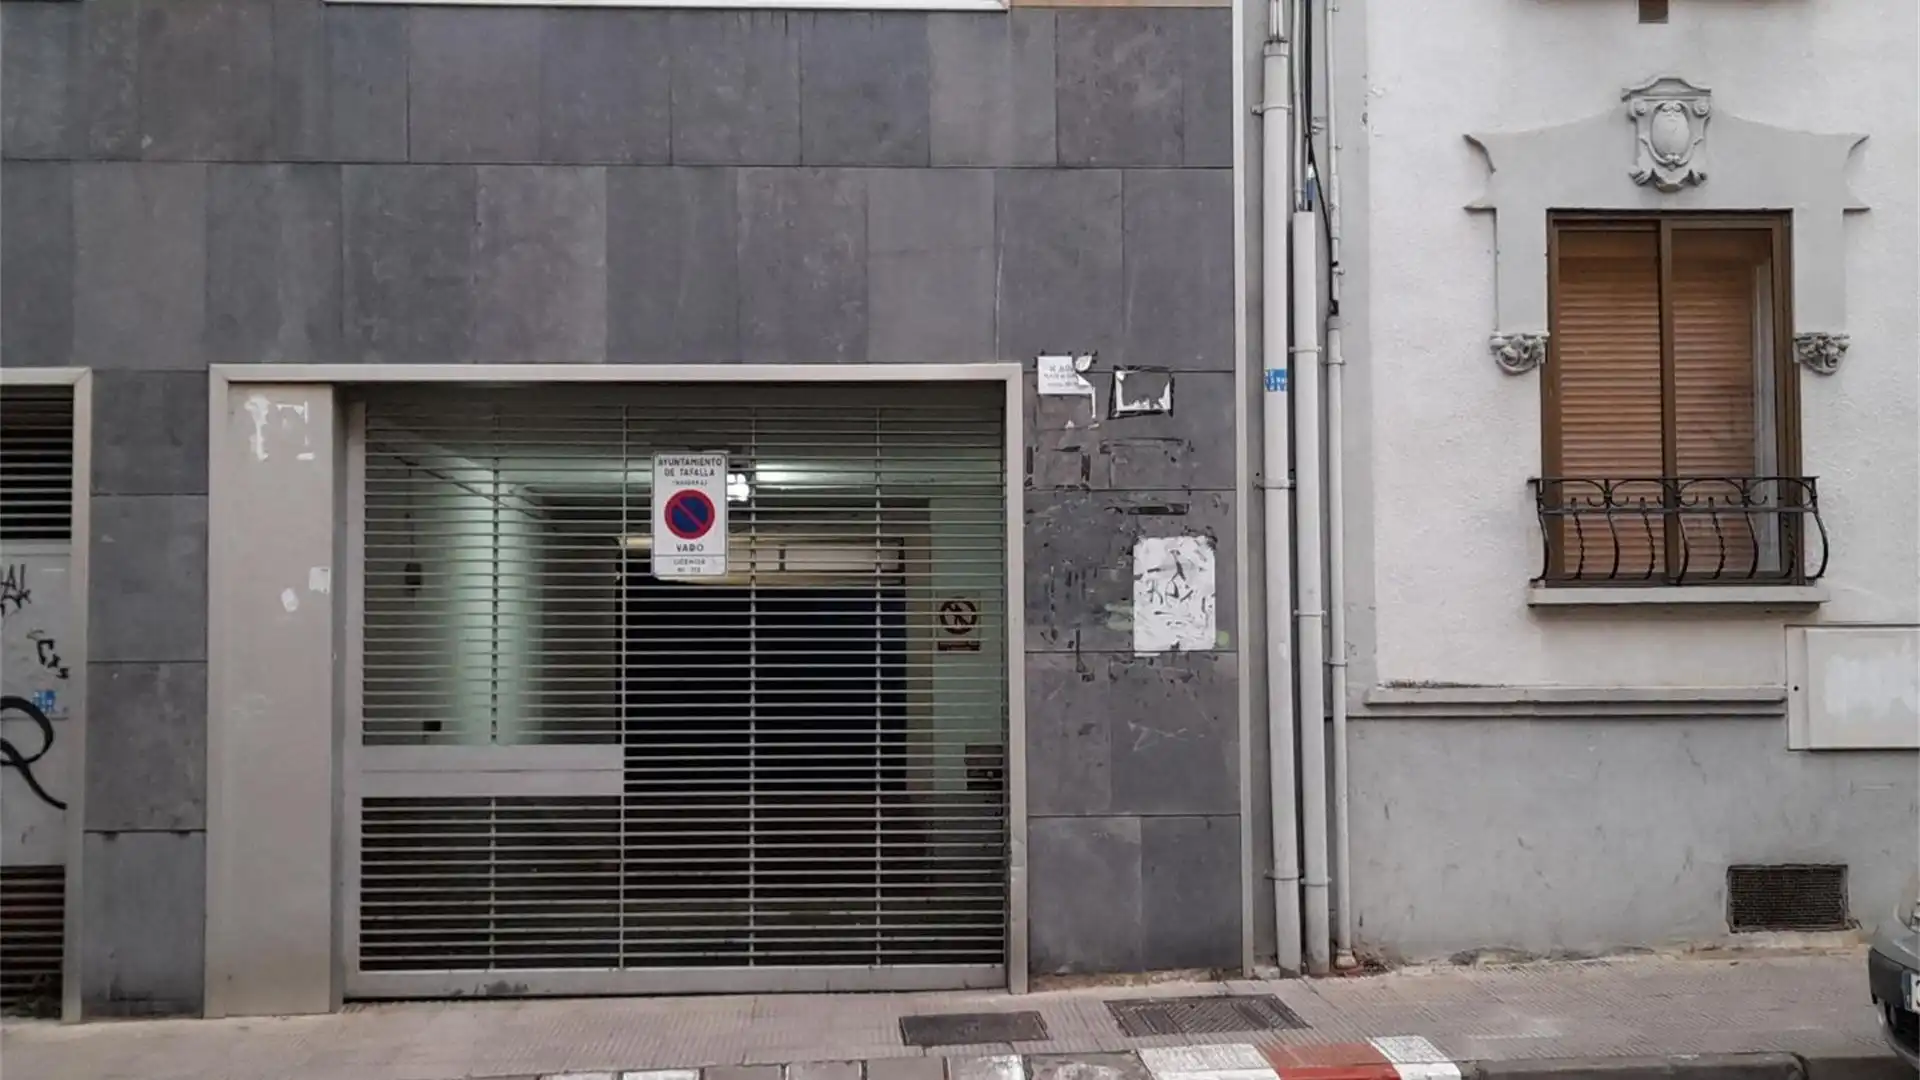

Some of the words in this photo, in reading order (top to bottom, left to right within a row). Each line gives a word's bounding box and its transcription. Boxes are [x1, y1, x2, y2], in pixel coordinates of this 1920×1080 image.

[658, 457, 722, 466] AYUNTAMIENTO
[664, 468, 675, 477] DE
[680, 468, 715, 477] TAFALLA
[676, 543, 704, 552] VADO
